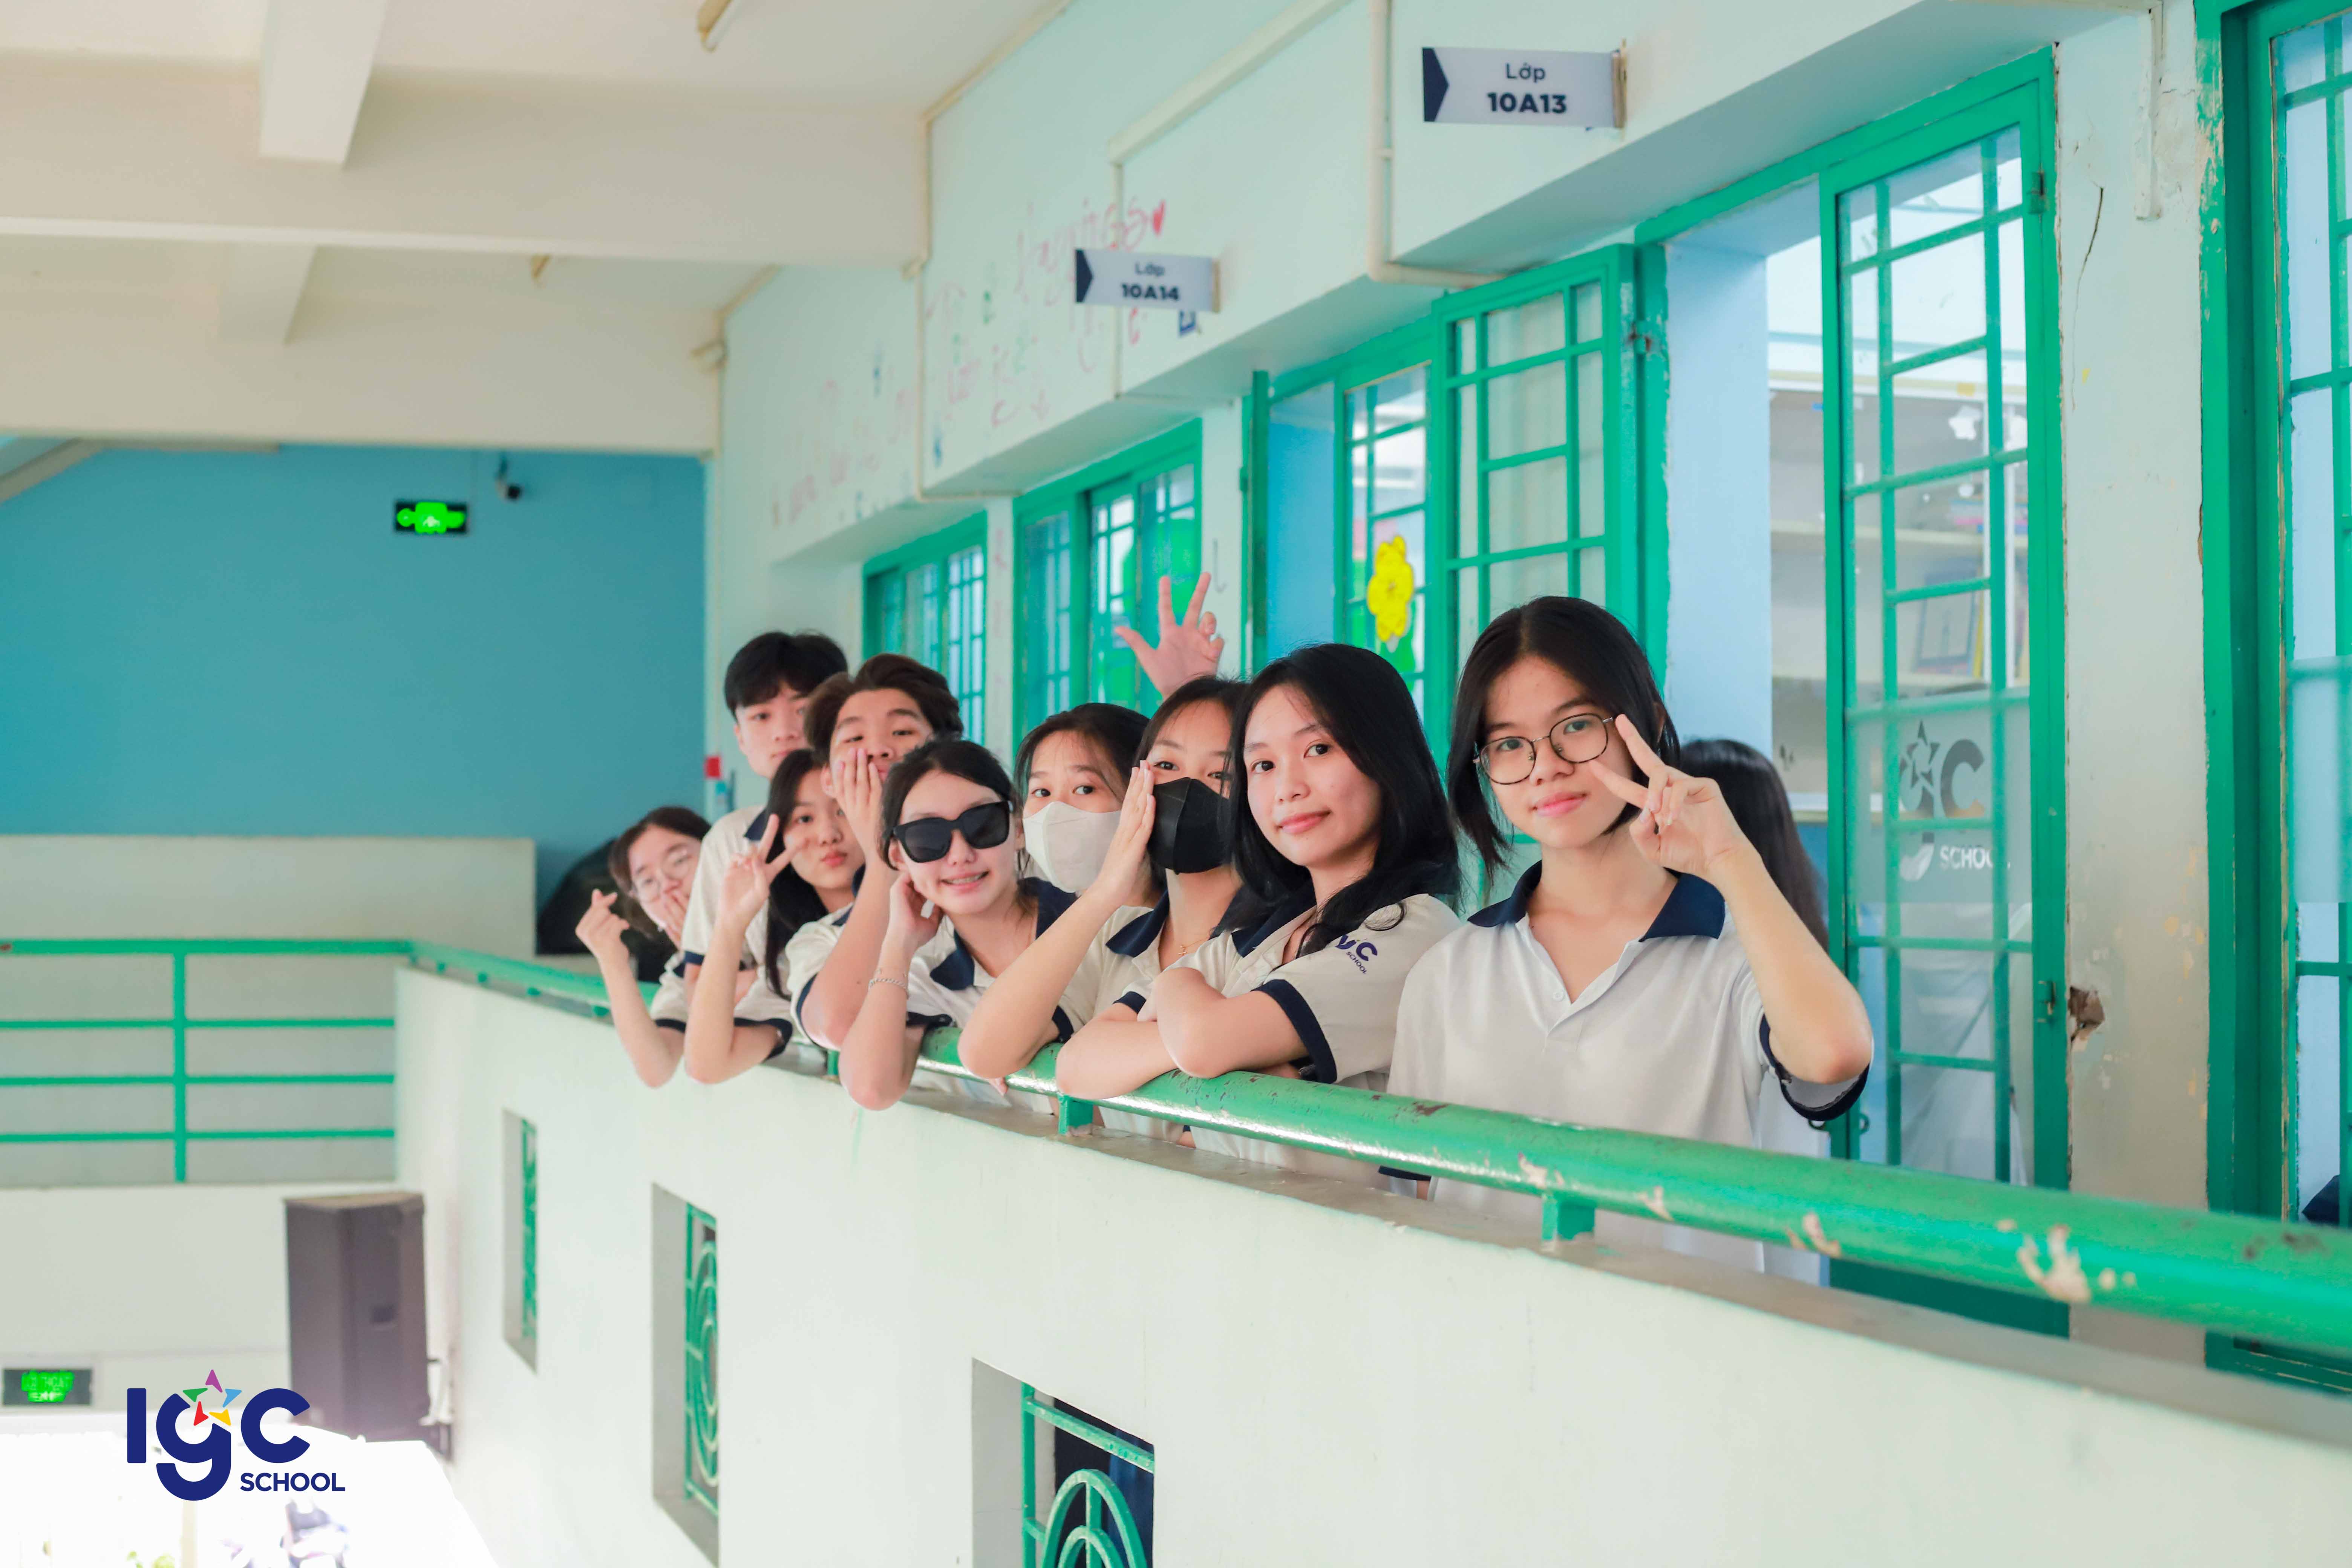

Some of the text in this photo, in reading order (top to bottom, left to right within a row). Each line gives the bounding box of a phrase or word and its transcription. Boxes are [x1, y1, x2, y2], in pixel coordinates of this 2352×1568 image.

[1506, 63, 1546, 83] Lớp
[1487, 91, 1567, 115] 10A13
[1121, 283, 1180, 301] 10A14
[1346, 951, 1367, 974] SCHOOL
